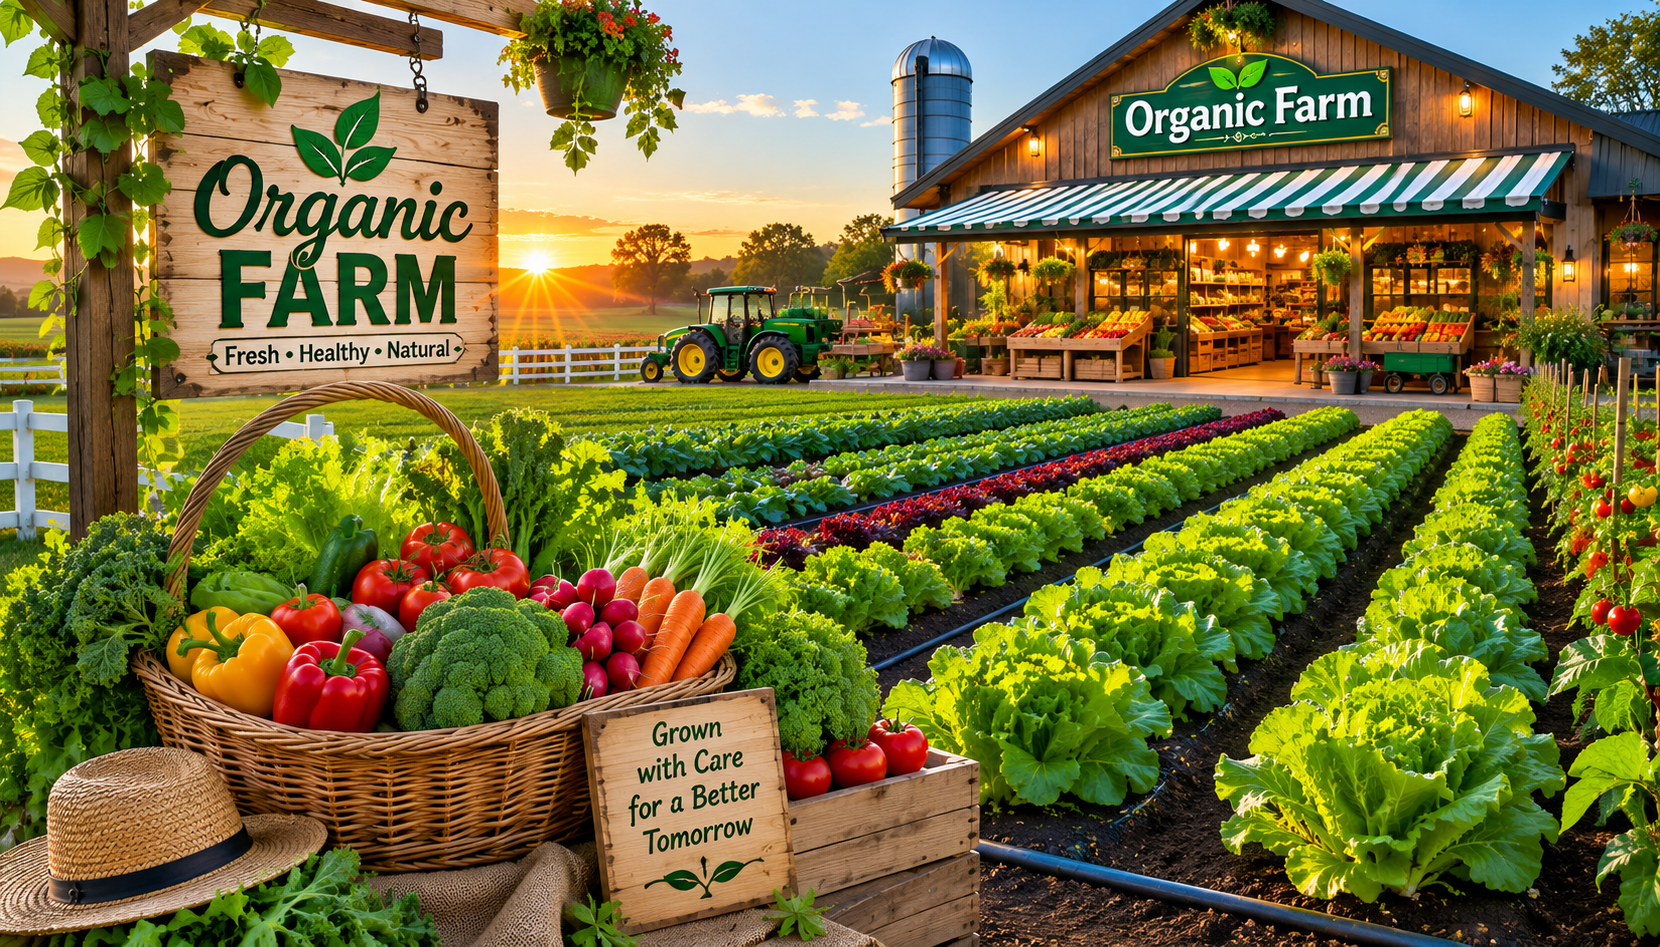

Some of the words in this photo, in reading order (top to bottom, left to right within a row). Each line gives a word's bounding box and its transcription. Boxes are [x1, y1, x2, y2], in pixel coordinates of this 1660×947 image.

[1125, 92, 1265, 143] Organic
[1275, 85, 1373, 124] Farm
[194, 154, 473, 269] Organic
[219, 249, 457, 328] FARM
[225, 343, 280, 366] Fresh
[299, 342, 370, 365] Healthy
[387, 339, 450, 359] Natural
[652, 720, 722, 747] Grown
[637, 753, 687, 784] with
[694, 749, 744, 774] Care
[628, 794, 662, 827] for
[670, 795, 684, 814] a
[691, 780, 760, 810] Better
[643, 817, 754, 855] Tomorrow
